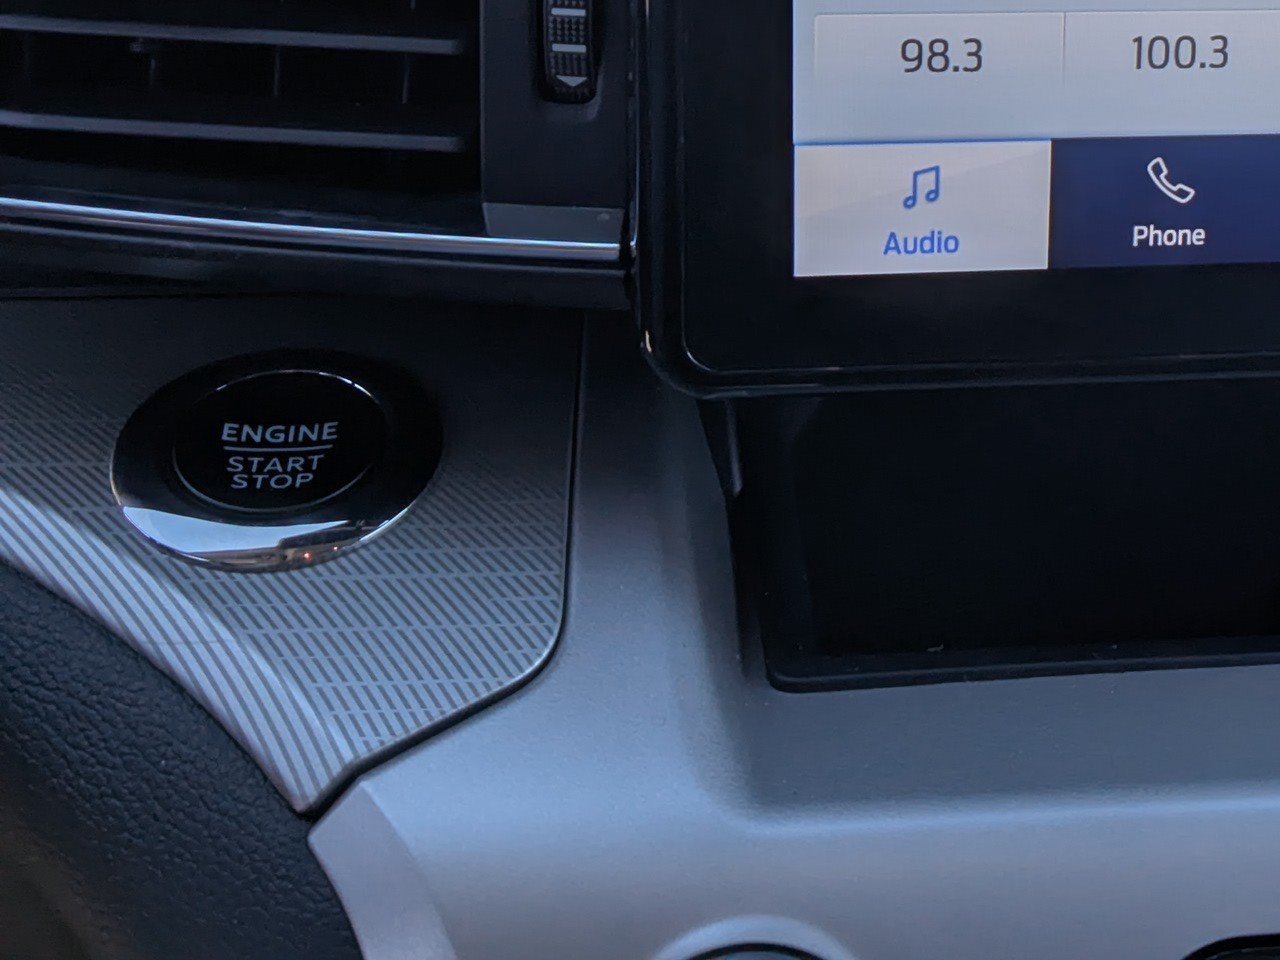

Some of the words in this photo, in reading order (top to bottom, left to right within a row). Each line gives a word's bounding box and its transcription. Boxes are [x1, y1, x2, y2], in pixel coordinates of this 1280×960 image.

[900, 37, 983, 73] 98.3
[1132, 35, 1229, 70] 100.3
[883, 231, 960, 256] Audio
[1132, 225, 1205, 248] Phone
[221, 422, 339, 443] ENGINE
[226, 454, 325, 473] START
[231, 473, 314, 490] STOP
